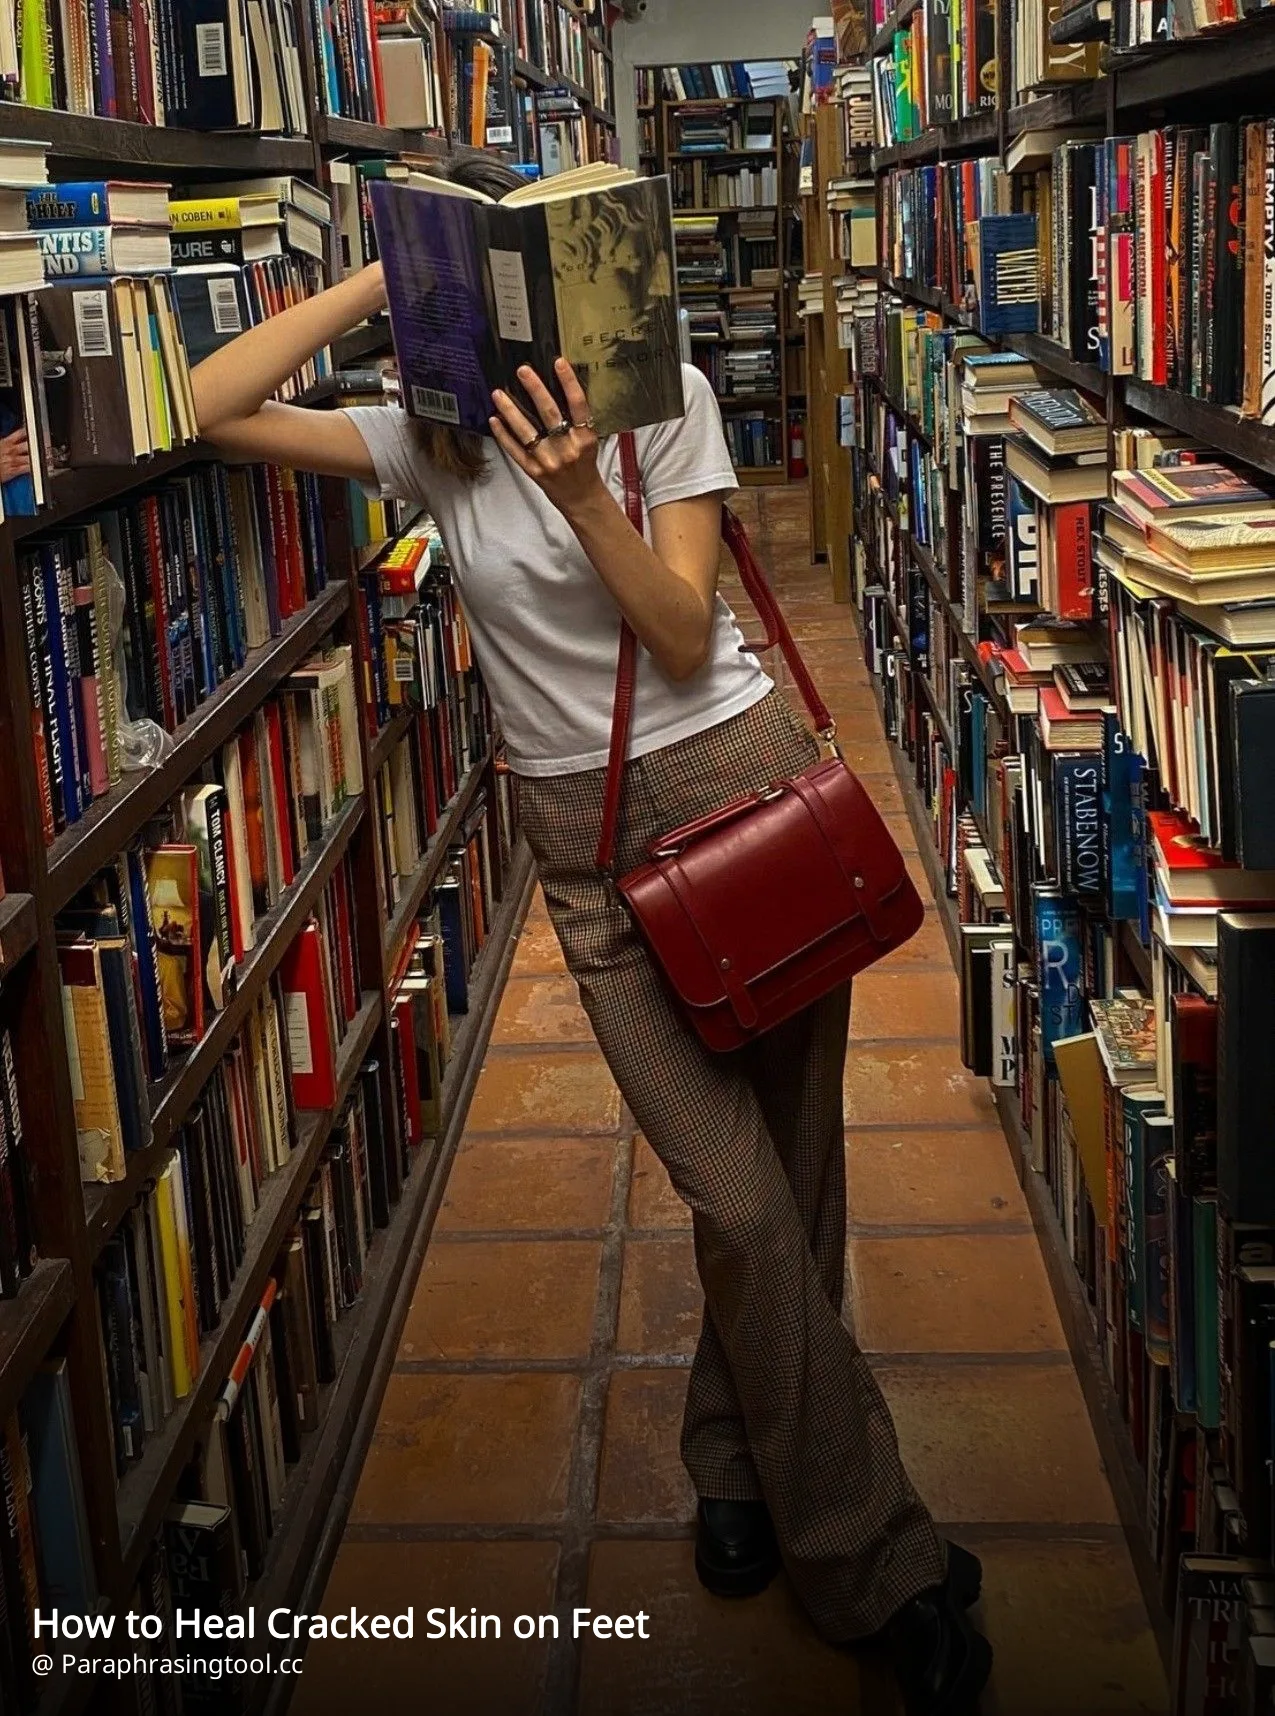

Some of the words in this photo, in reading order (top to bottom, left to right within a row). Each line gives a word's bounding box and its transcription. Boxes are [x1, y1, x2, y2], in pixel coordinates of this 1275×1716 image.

[1164, 141, 1173, 171] JULIE
[1164, 175, 1173, 210] SMITH
[181, 211, 214, 223] COBEN
[40, 230, 94, 255] NTIS
[582, 321, 656, 347] SECRE
[1263, 324, 1272, 367] SCOTT
[989, 444, 1004, 468] THE
[990, 475, 1005, 539] PRESENCE
[1076, 516, 1086, 541] REX
[1077, 545, 1086, 585] STOUT
[22, 584, 36, 649] STEPHEN
[29, 652, 42, 709] COONTS
[43, 654, 58, 714] FINAL
[49, 718, 65, 784] FLIGHT
[210, 809, 222, 838] TOM
[1074, 767, 1099, 890] STABENOW
[213, 841, 226, 886] CLANCY
